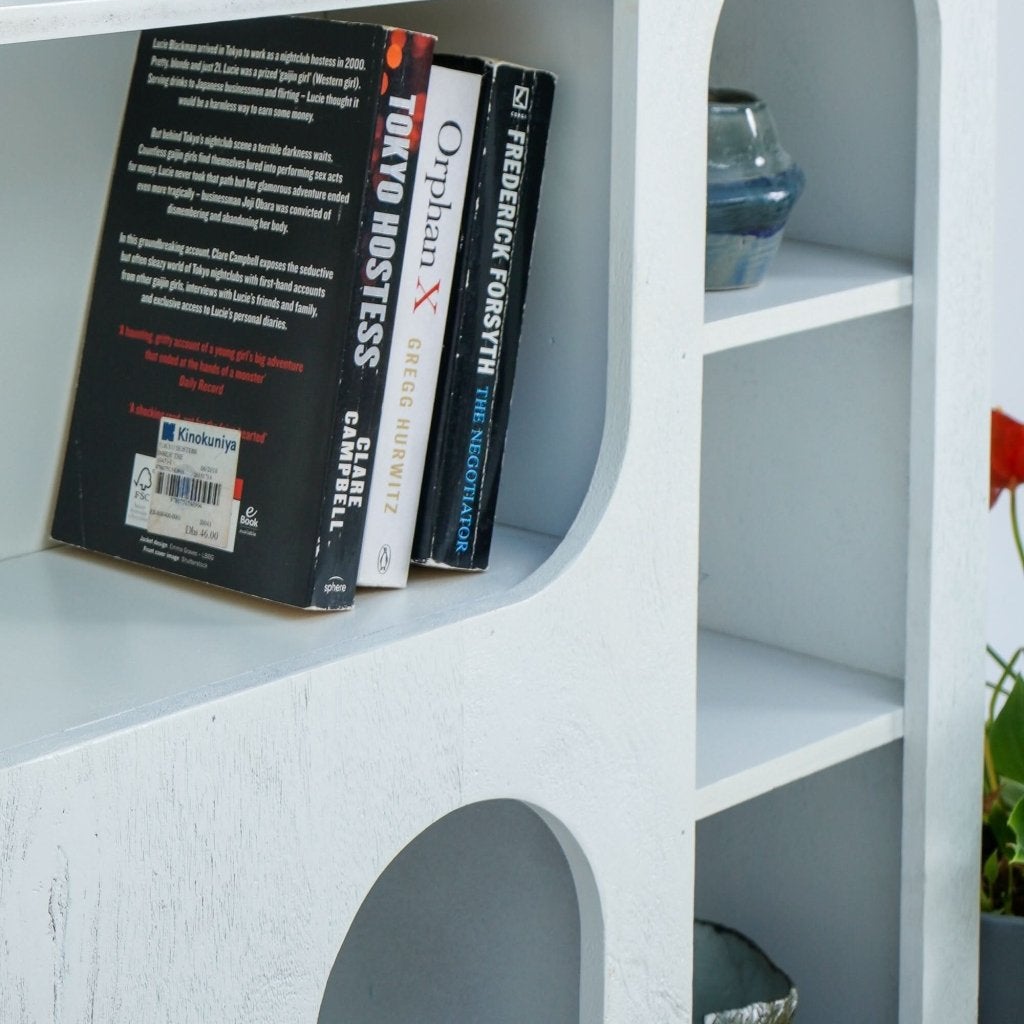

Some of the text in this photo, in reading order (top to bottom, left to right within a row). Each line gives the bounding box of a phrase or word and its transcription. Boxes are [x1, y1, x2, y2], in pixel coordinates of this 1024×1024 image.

[250, 49, 265, 59] work
[266, 51, 274, 60] as
[274, 52, 279, 60] a
[280, 51, 310, 64] nightclub
[310, 54, 336, 67] hostess
[336, 57, 344, 67] in
[344, 57, 366, 70] 2000.
[257, 68, 278, 79] prized
[297, 72, 312, 84] girl'
[312, 72, 343, 86] (Western
[343, 76, 361, 90] girl).
[264, 87, 277, 98] and
[277, 88, 300, 102] flirting
[306, 91, 325, 103] Lucie
[325, 93, 352, 108] thought
[352, 96, 359, 108] it
[258, 106, 273, 116] earn
[273, 108, 291, 118] some
[291, 110, 314, 123] money.
[258, 143, 282, 155] terrible
[282, 145, 312, 159] darkness
[313, 150, 333, 162] waits.
[263, 161, 276, 173] into
[276, 164, 314, 181] performing
[314, 171, 327, 180] sex
[327, 173, 343, 183] acts
[257, 180, 291, 195] glamorous
[292, 185, 326, 200] adventure
[327, 191, 350, 204] ended
[255, 198, 274, 211] Obara
[275, 204, 288, 214] was
[289, 206, 323, 219] convicted
[323, 209, 332, 220] of
[413, 120, 463, 315] Orphan X
[259, 218, 271, 229] her
[270, 219, 288, 234] body.
[354, 95, 416, 368] TOKYO HOSTESS
[477, 129, 525, 375] FREDERICK FORSYTH
[192, 263, 210, 278] Tokyo
[210, 267, 243, 282] nightclubs
[244, 274, 258, 285] with
[259, 275, 293, 292] first-hand
[293, 284, 325, 298] accounts
[259, 259, 286, 271] exposes
[287, 261, 298, 273] the
[299, 264, 333, 279] seductive
[185, 281, 218, 297] interviews
[218, 288, 232, 299] with
[232, 290, 255, 304] Lucie's
[256, 294, 280, 309] friends
[280, 300, 294, 311] and
[294, 301, 317, 318] family,
[203, 305, 210, 315] to
[210, 305, 233, 319] Lucie's
[233, 312, 262, 324] personal
[262, 315, 287, 330] diaries.
[384, 337, 422, 514] GREGG HURWITZ
[178, 426, 236, 454] Kinokuniya
[329, 410, 359, 532] CAMPBELL
[347, 436, 371, 508] CLARE
[456, 385, 489, 553] THE NEGOTIATOR
[239, 516, 259, 528] Book
[324, 582, 347, 593] sphere
